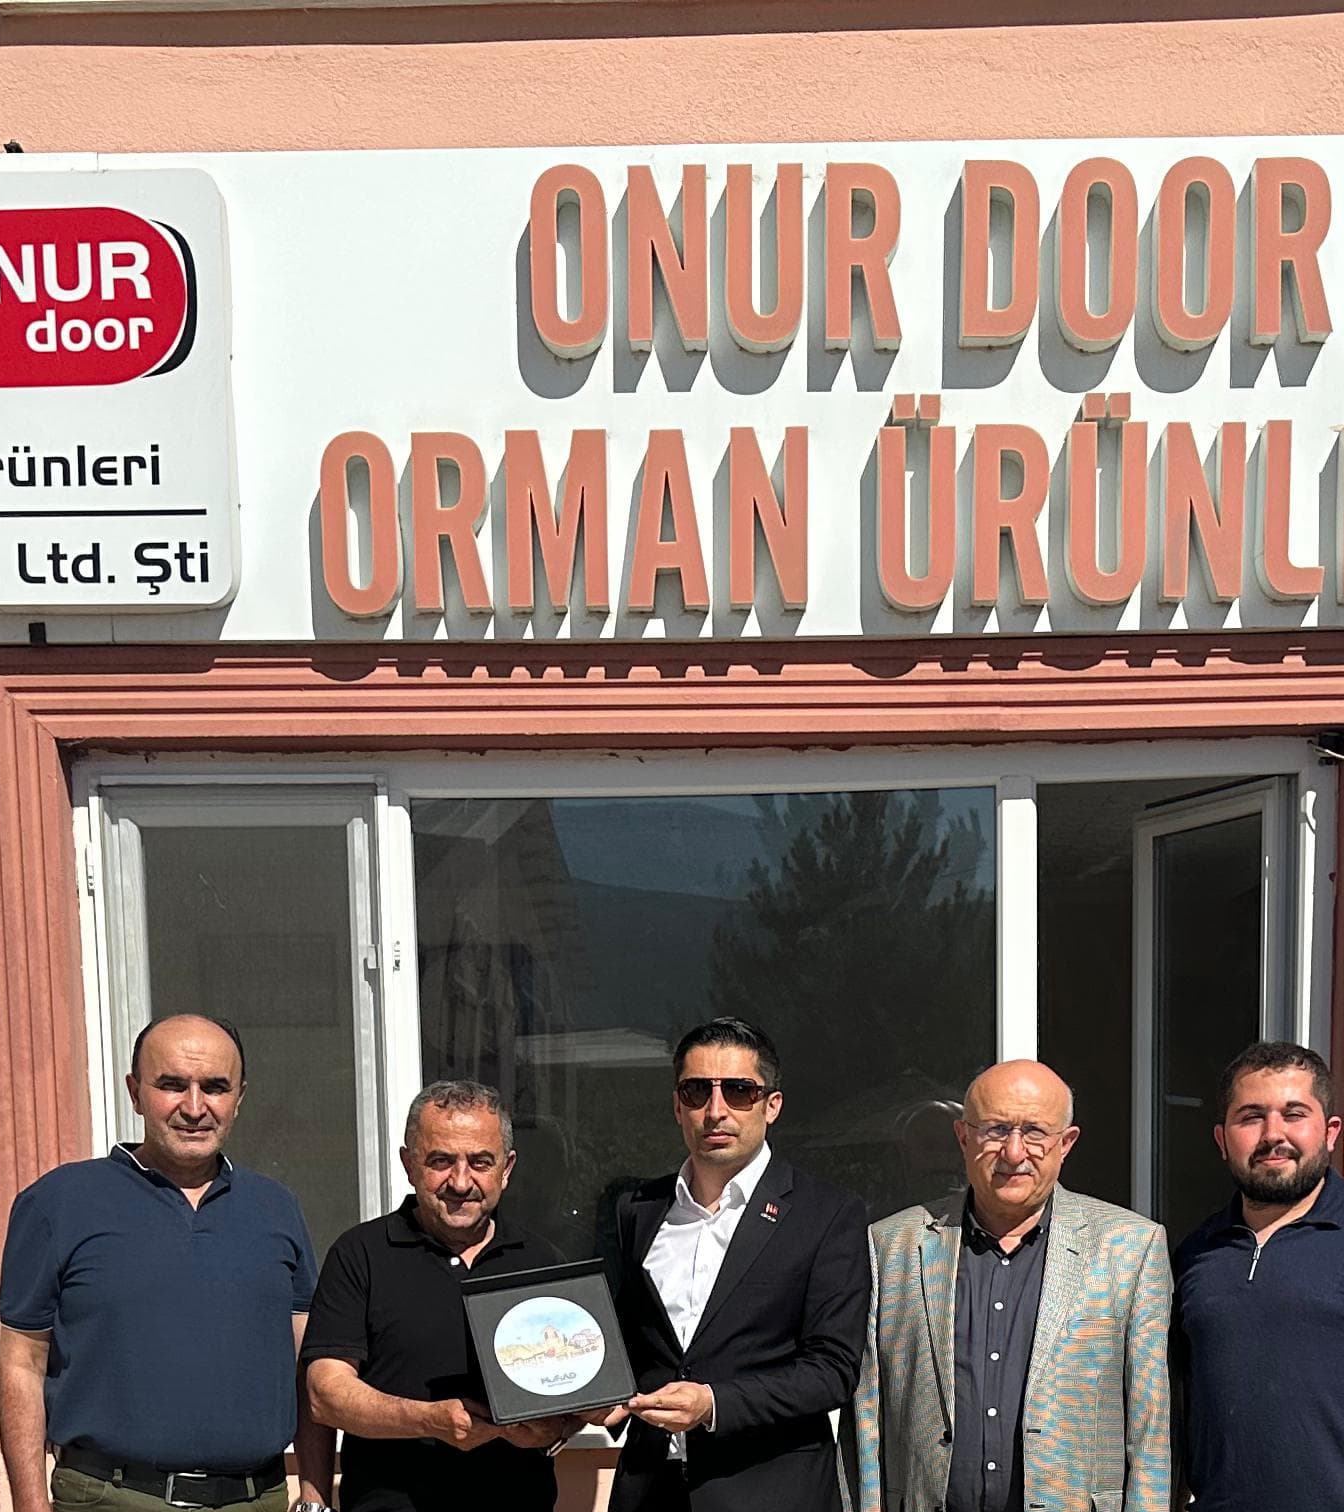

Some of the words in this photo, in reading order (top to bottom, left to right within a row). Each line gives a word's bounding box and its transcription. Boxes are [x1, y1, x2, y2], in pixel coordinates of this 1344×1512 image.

[528, 157, 903, 354] ONUR
[958, 152, 1335, 350] DOOR
[25, 309, 154, 353] door
[17, 542, 116, 585] Ltd.
[134, 541, 209, 596] Şti
[318, 426, 809, 615] ORMAN
